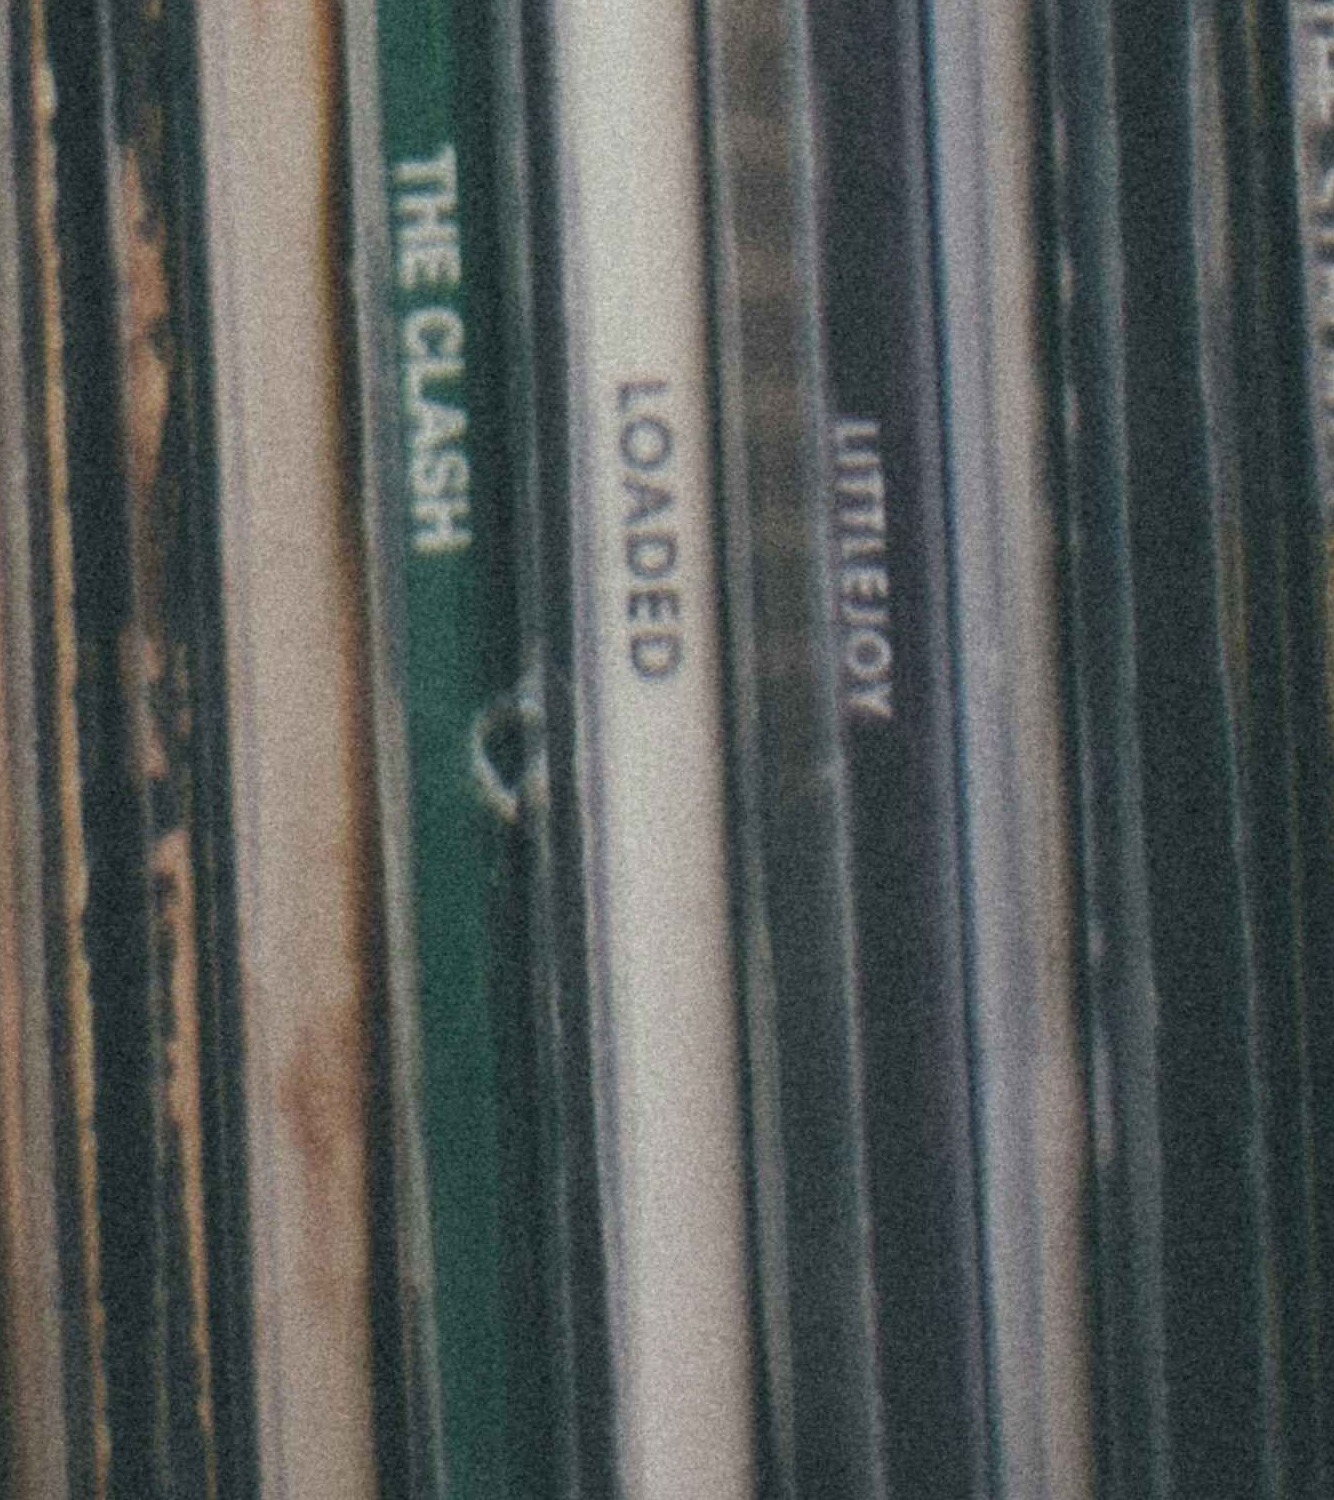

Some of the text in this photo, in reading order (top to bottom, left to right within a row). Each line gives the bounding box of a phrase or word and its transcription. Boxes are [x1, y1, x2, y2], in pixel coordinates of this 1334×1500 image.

[394, 143, 470, 552] THE CLASH
[615, 377, 682, 683] LOADED
[830, 419, 893, 719] LITTLEJOY
